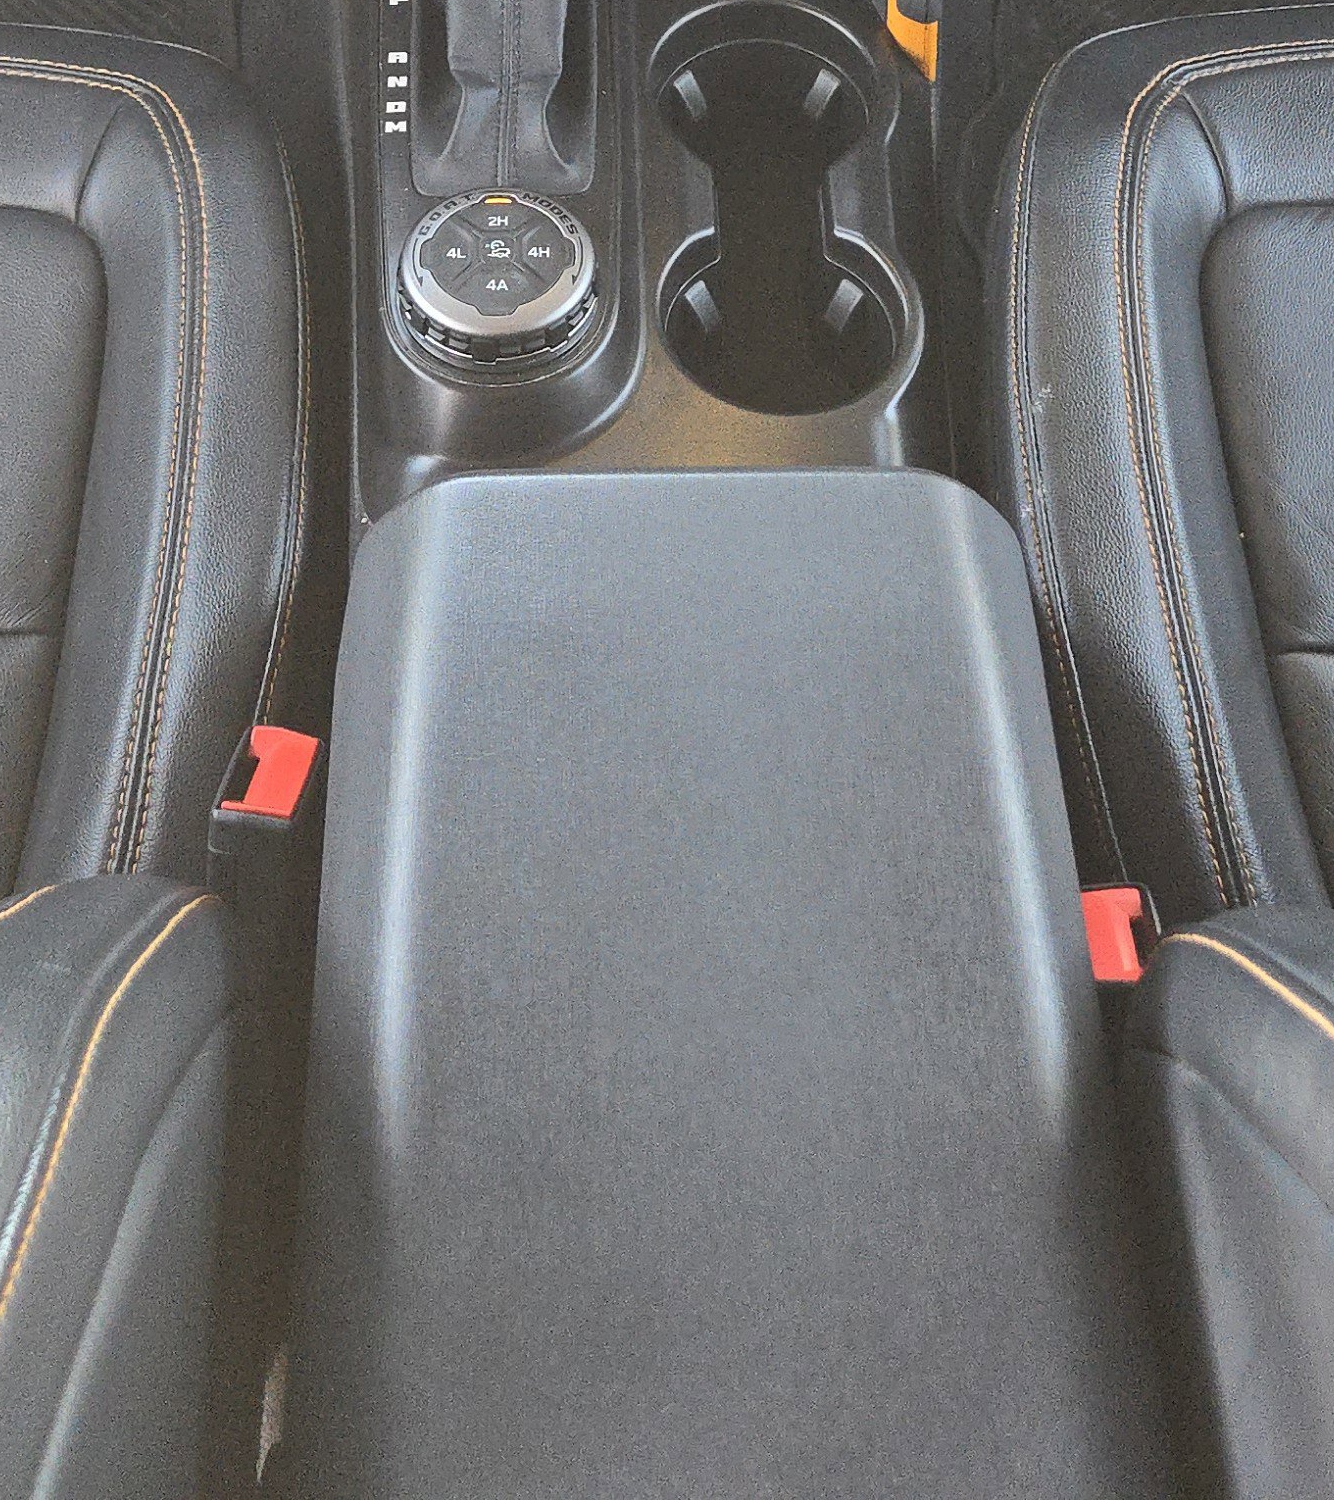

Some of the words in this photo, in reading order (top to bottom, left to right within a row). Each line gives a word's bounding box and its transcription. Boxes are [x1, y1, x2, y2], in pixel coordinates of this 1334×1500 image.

[387, 75, 408, 88] N
[385, 101, 407, 113] D
[384, 120, 407, 133] M
[522, 191, 580, 235] MODES
[487, 215, 509, 227] 2H
[446, 247, 467, 259] 4L
[527, 246, 550, 258] 4H
[485, 279, 509, 291] 4A
